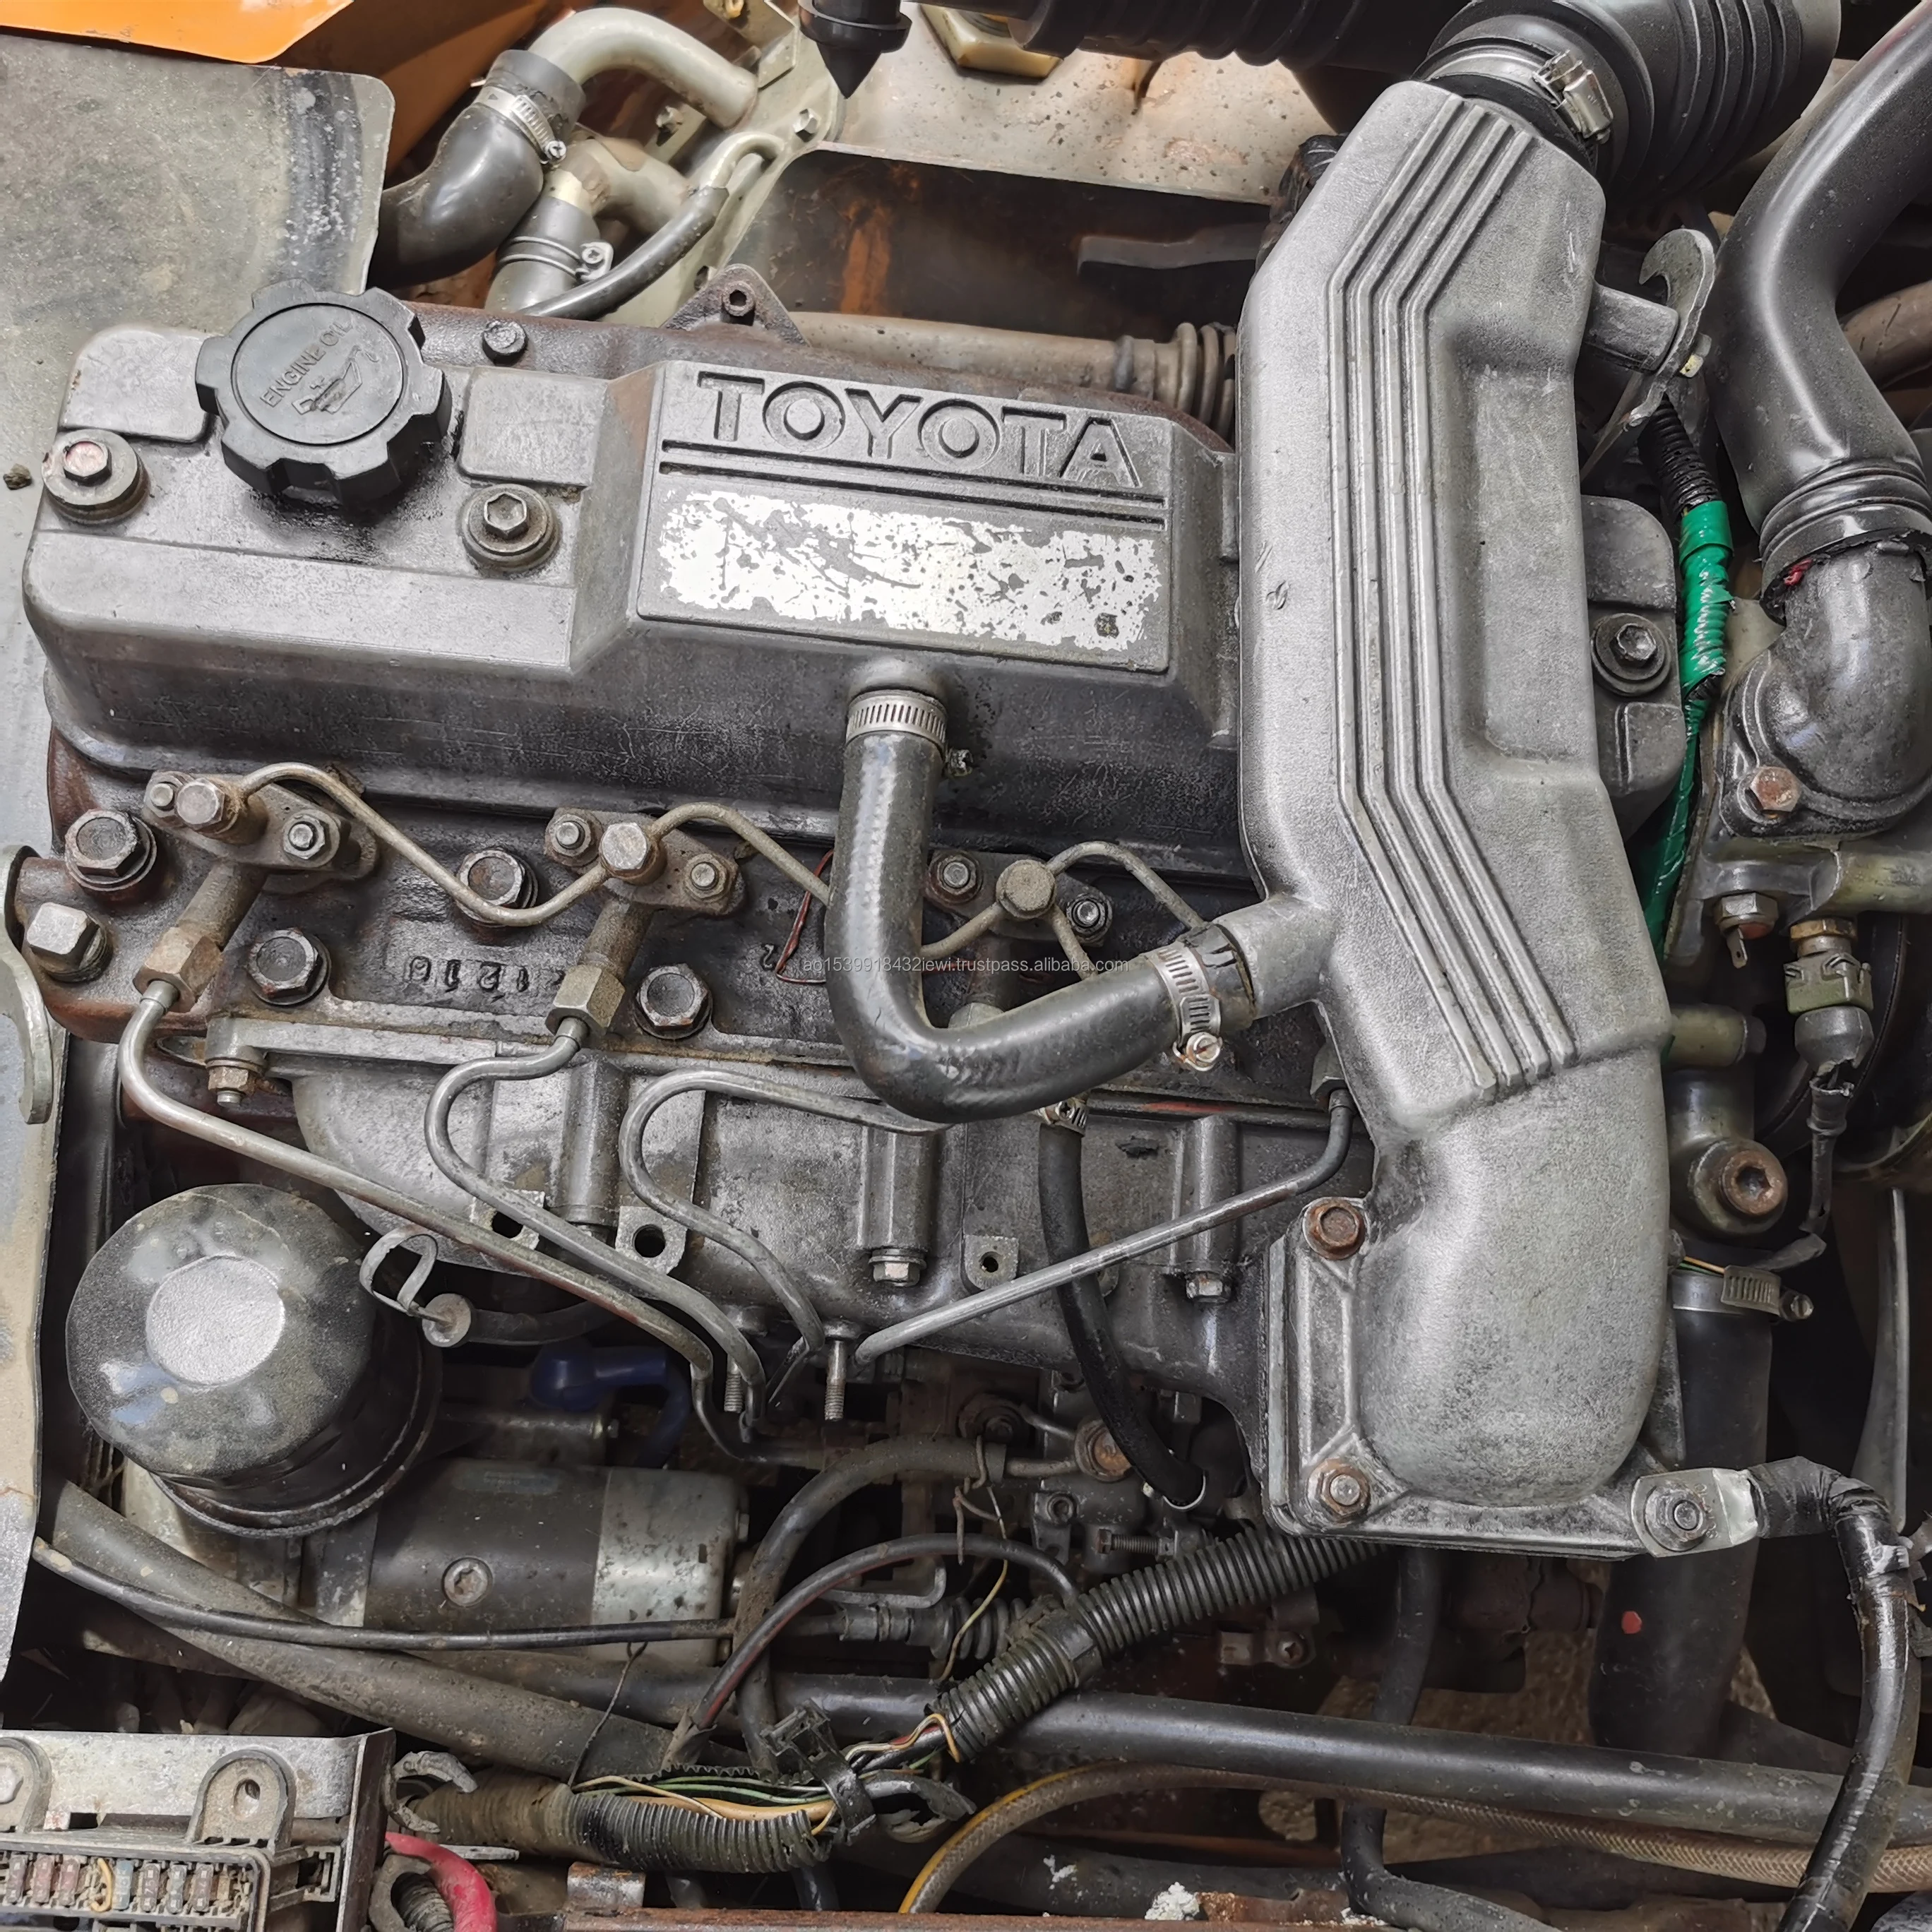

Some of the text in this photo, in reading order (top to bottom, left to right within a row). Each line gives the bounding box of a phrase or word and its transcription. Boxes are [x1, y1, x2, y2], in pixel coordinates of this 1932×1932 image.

[260, 320, 354, 407] ENGINE OIL
[696, 371, 1142, 488] TOYOTA
